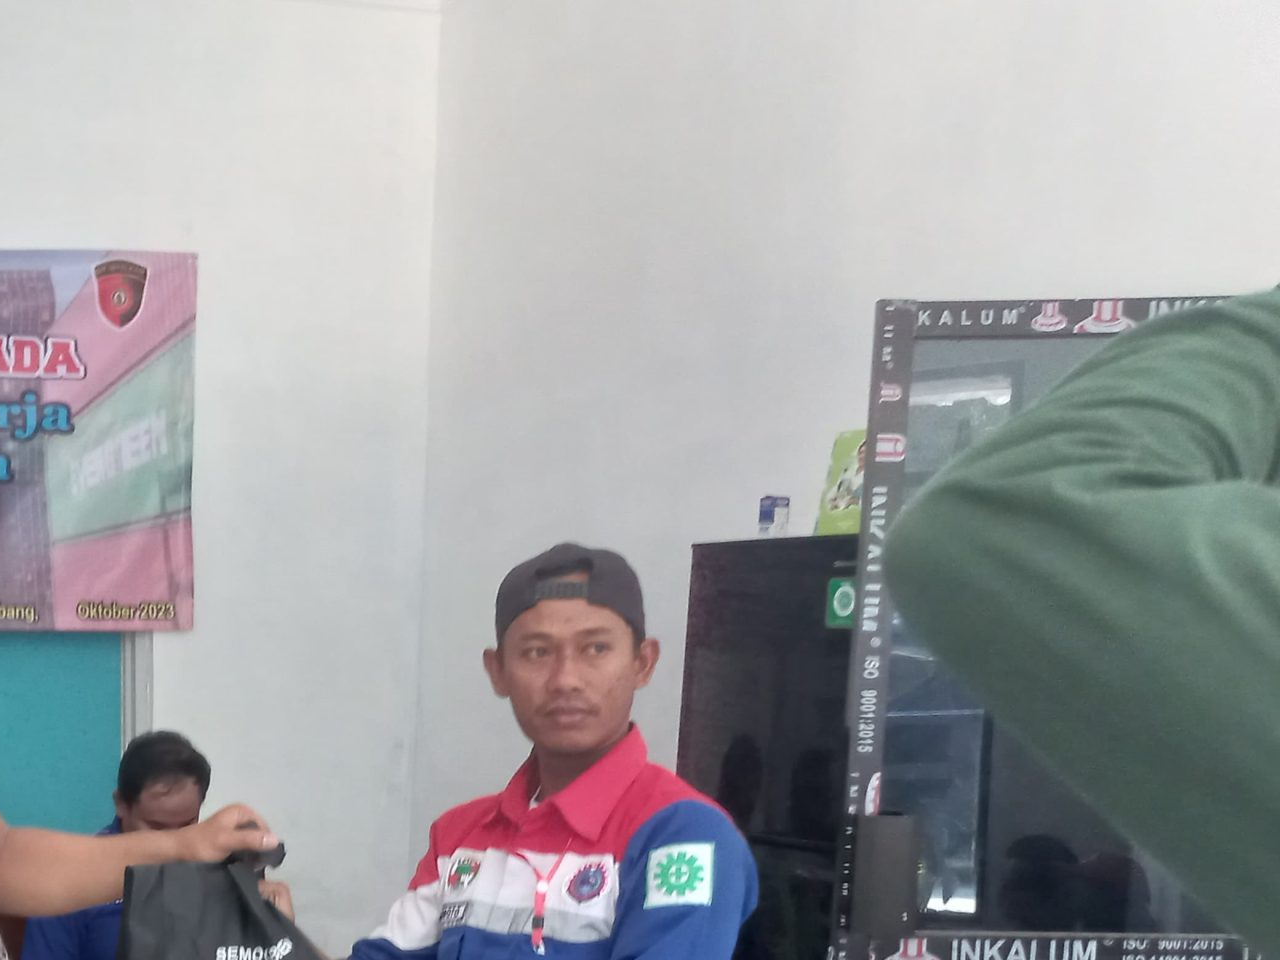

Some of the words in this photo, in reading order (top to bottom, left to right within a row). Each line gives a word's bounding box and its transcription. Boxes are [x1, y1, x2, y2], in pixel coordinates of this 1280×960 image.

[76, 602, 137, 620] Oktober
[138, 603, 176, 620] 2023
[863, 655, 880, 679] ISO
